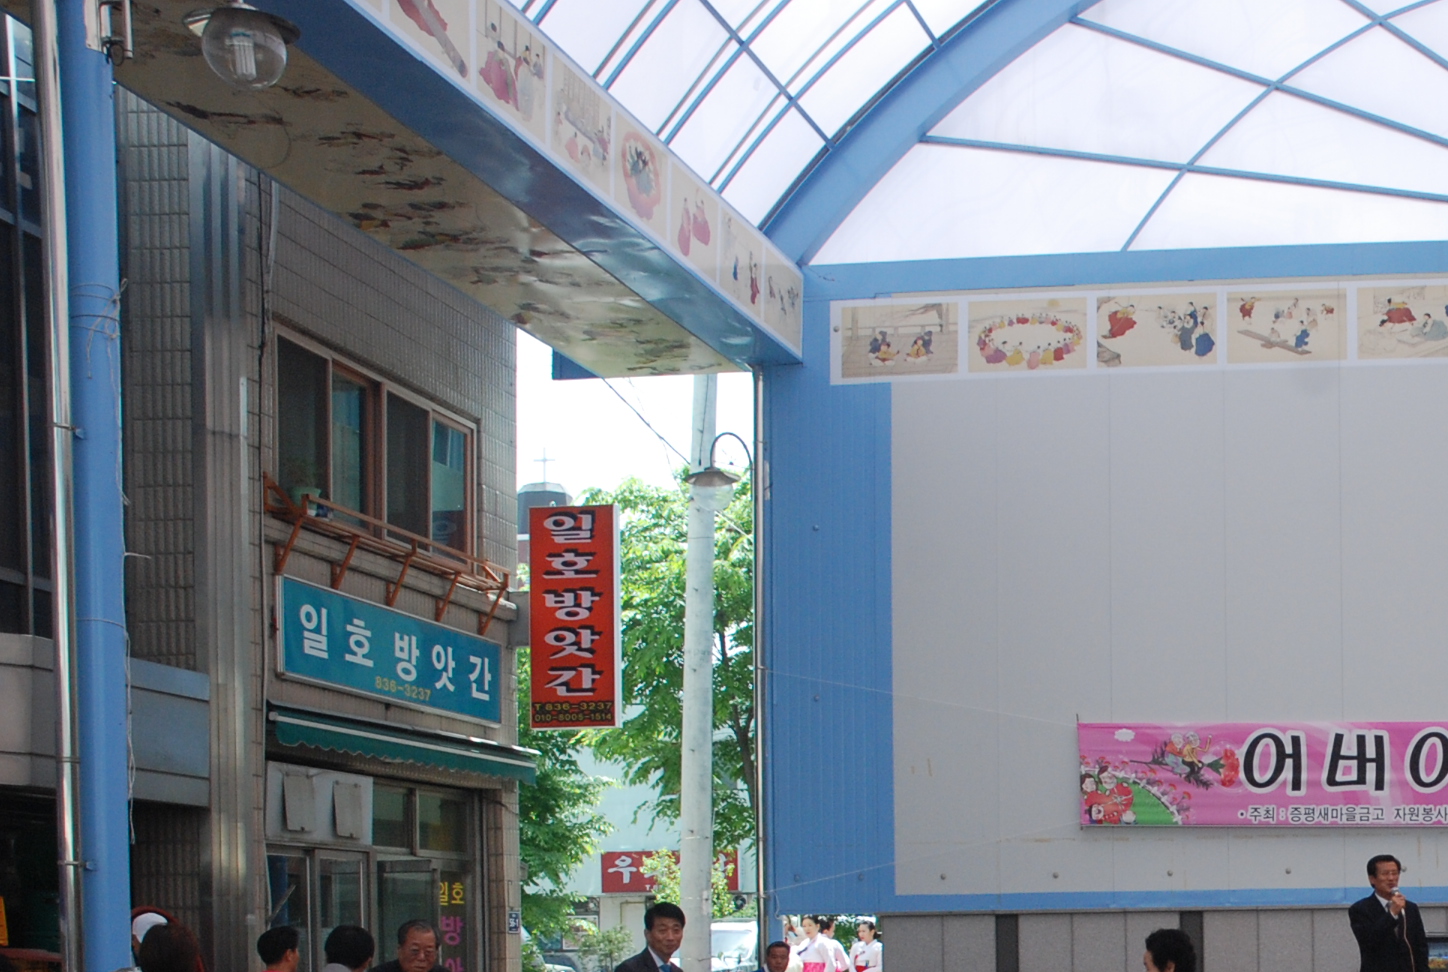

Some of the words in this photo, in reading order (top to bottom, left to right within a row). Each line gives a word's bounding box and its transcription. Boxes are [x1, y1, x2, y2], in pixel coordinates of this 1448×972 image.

[543, 511, 603, 696] 일호방앗간
[374, 675, 432, 702] 836-3237
[1289, 806, 1386, 822] 증평새마을금고
